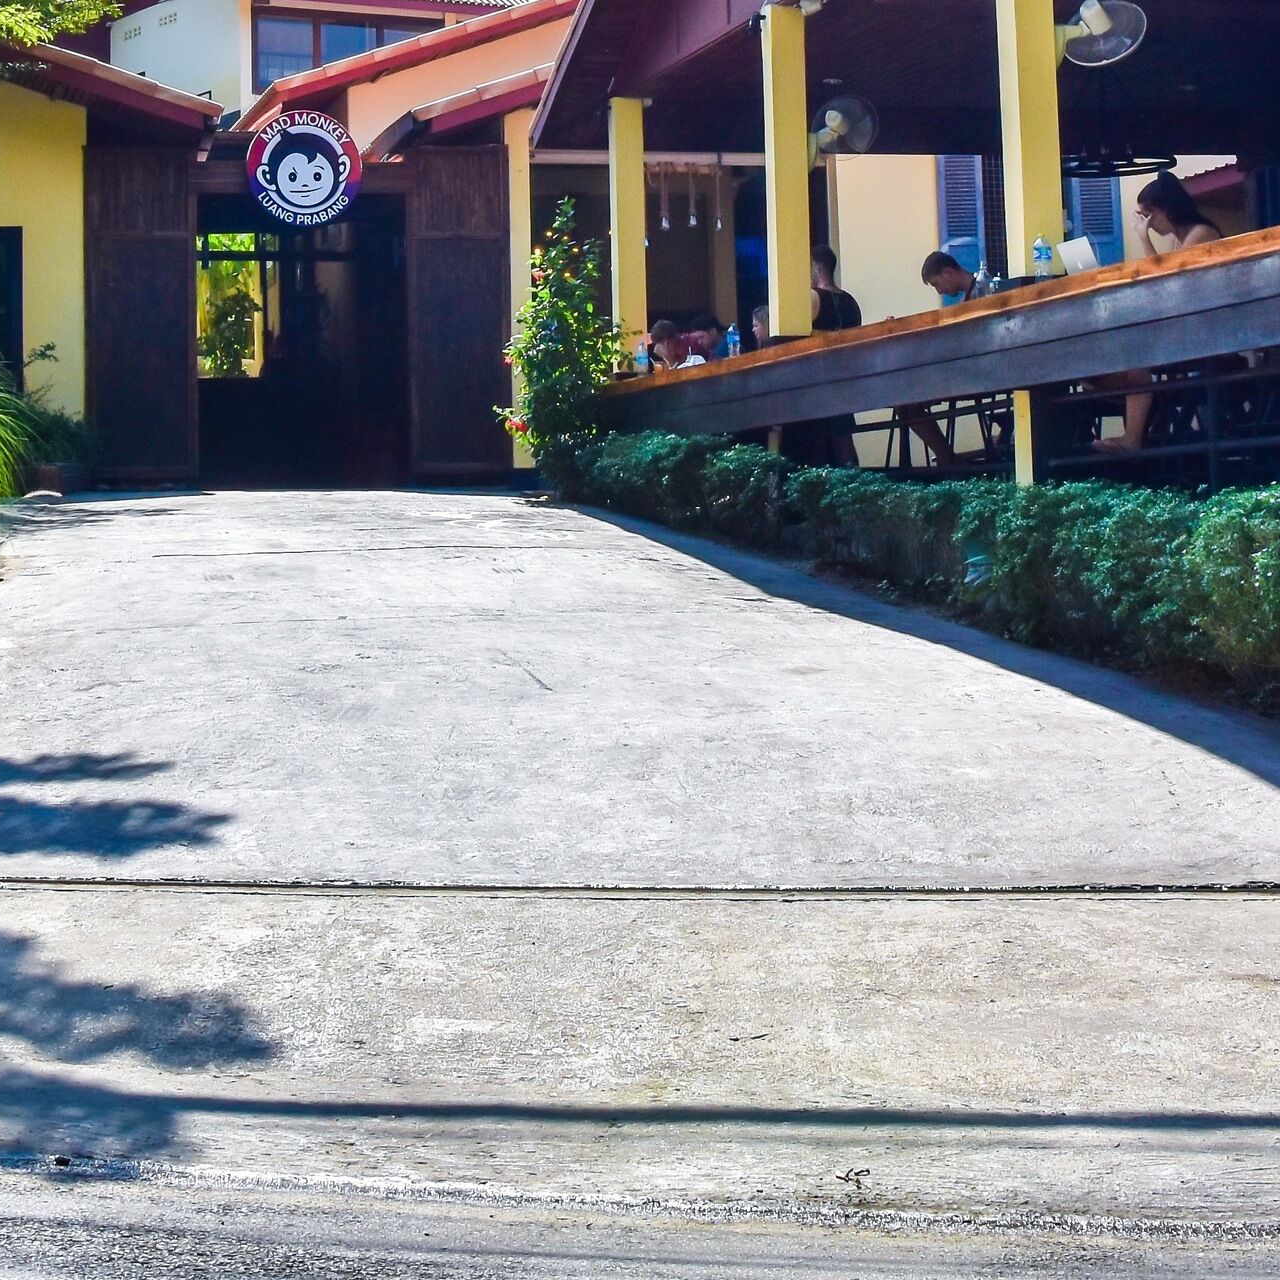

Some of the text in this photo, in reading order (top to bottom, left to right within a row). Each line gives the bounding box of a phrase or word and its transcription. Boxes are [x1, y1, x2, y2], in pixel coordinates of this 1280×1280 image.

[260, 113, 351, 145] MAD MONKEY
[257, 191, 349, 225] LUANG PRABANG
